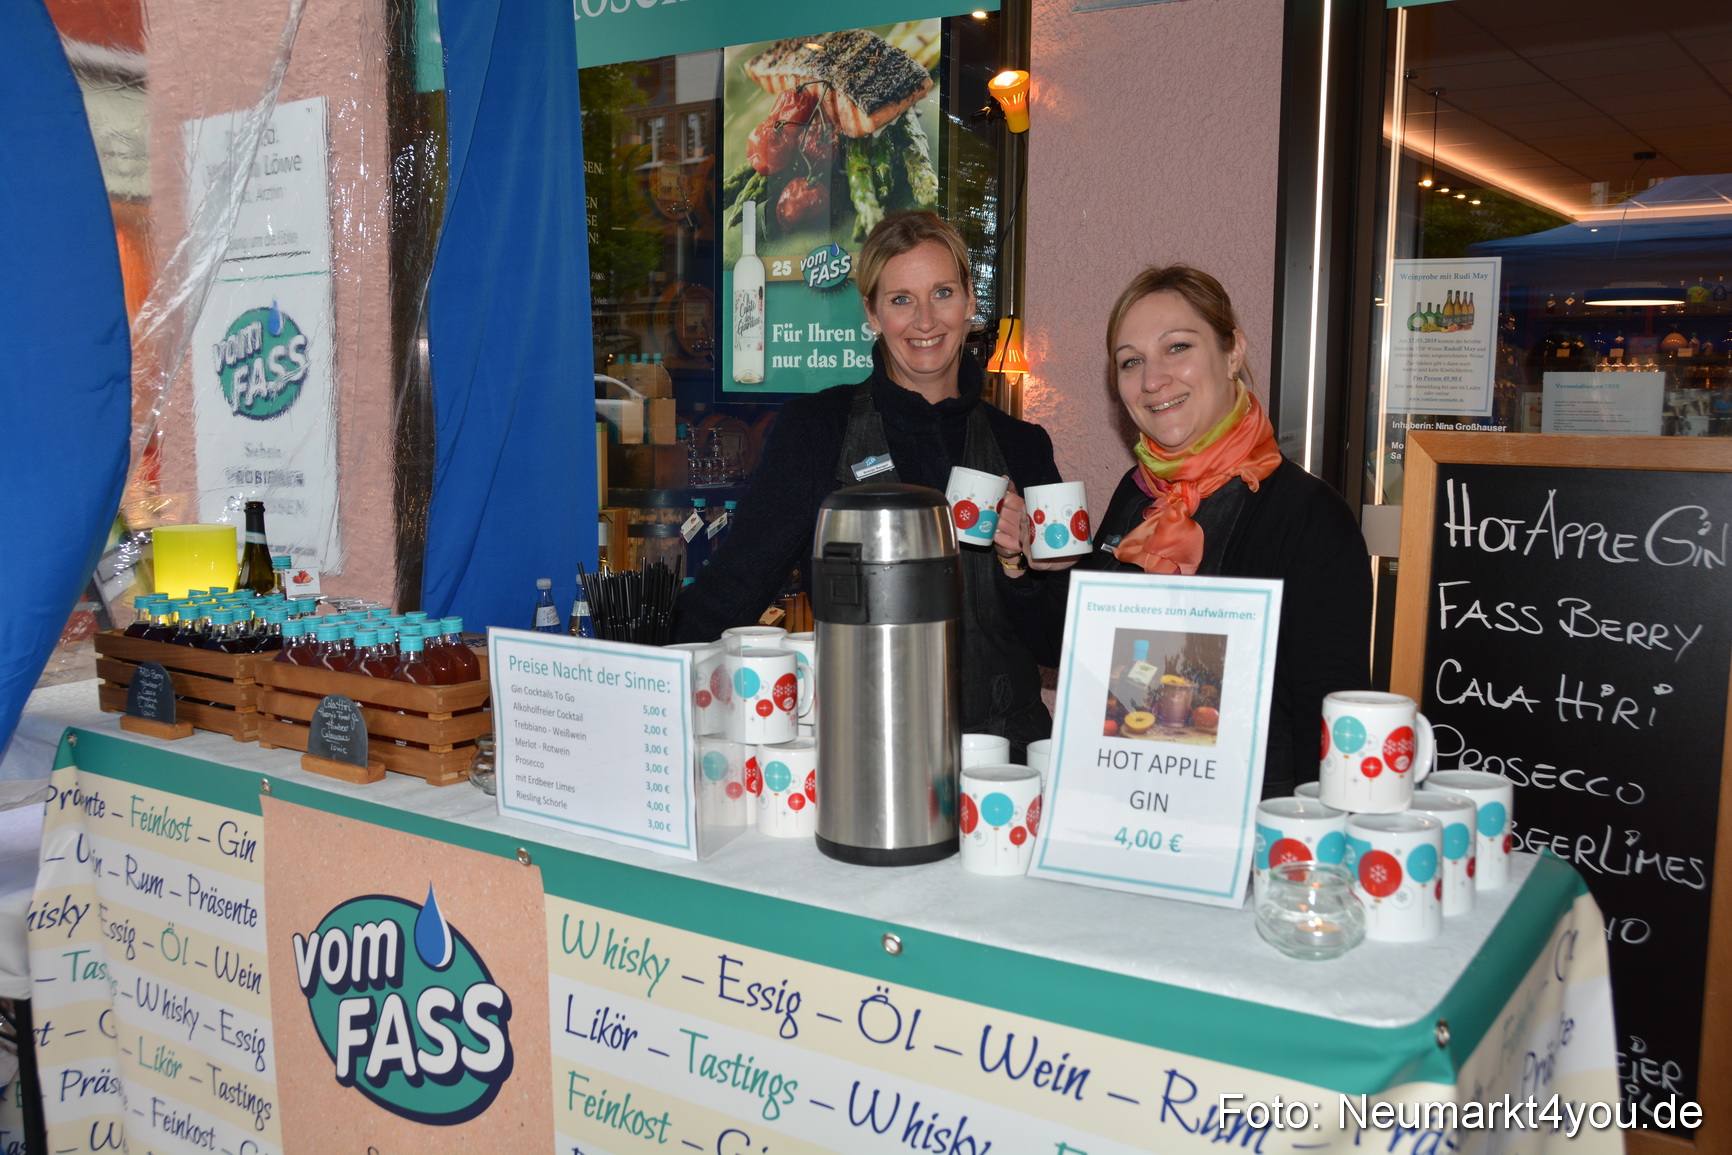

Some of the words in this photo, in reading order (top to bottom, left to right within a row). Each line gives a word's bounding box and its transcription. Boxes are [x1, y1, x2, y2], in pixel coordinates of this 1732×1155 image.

[772, 260, 793, 277] 25
[800, 249, 827, 272] vom
[809, 254, 852, 287] FASS
[1400, 273, 1438, 281] Weinprobe
[1472, 273, 1489, 281] May
[772, 323, 802, 342] Für
[808, 322, 856, 342] Ihren
[772, 354, 801, 368] nur
[807, 348, 837, 368] das
[1392, 421, 1434, 430] Inhaberin:
[1435, 422, 1454, 431] Nina
[1455, 422, 1507, 432] Großhauser
[1391, 441, 1404, 449] Mo
[1390, 452, 1402, 460] Sa
[1086, 601, 1117, 613] Etwas
[1118, 603, 1163, 616] Leckeres
[1164, 606, 1187, 617] zum
[1189, 606, 1256, 621] Aufwärmen:
[1437, 580, 1544, 635] FASS
[1557, 597, 1704, 663] BERRY
[508, 655, 549, 676] Preise
[552, 661, 593, 683] Nacht
[597, 667, 621, 687] der
[624, 671, 671, 694] Sinne:
[510, 684, 523, 694] Gin
[523, 686, 554, 700] Cocktails
[554, 690, 564, 701] To
[564, 692, 575, 703] Go
[1435, 658, 1541, 714] CALA
[512, 702, 555, 717] Alkoholfreier
[556, 708, 584, 722] Cocktail
[643, 705, 660, 717] 5,00
[661, 708, 667, 717] €
[514, 720, 547, 735] Trebbiano
[552, 726, 587, 741] Weißwein
[643, 724, 661, 736] 2,00
[662, 728, 668, 737] €
[514, 737, 538, 749] Merlot
[542, 742, 570, 756] Rotwein
[644, 743, 662, 755] 3,00
[663, 747, 668, 756] €
[515, 755, 545, 769] Prosecco
[645, 762, 662, 774] 3,00
[663, 766, 669, 775] €
[1097, 748, 1143, 771] HOT
[1148, 754, 1217, 780] APPLE
[1432, 724, 1645, 805] PROSECCO
[515, 773, 527, 784] mit
[528, 775, 554, 790] Erdbeer
[555, 781, 575, 794] Limes
[646, 781, 663, 793] 3,00
[664, 785, 670, 794] €
[516, 790, 542, 805] Riesling
[542, 795, 568, 810] Schorle
[646, 800, 664, 812] 4,00
[665, 804, 671, 813] €
[1129, 790, 1169, 813] GIN
[130, 795, 193, 843] Feinkost
[217, 820, 257, 863] Gin
[648, 819, 665, 831] 3,00
[666, 823, 671, 832] €
[1114, 826, 1162, 852] 4,00
[1168, 833, 1184, 853] €
[125, 854, 164, 899] Rum
[188, 873, 258, 928] Präsente
[161, 922, 188, 966] Öl
[215, 946, 262, 995] Wein
[292, 917, 404, 997] vom
[561, 913, 670, 998] Whisky
[718, 954, 802, 1040] Essig
[858, 985, 921, 1051] Öl
[979, 1024, 1091, 1101] Wein
[136, 977, 200, 1041] Whisky
[219, 1008, 266, 1072] Essig
[336, 981, 512, 1087] FASS
[565, 993, 639, 1051] Likör
[679, 1027, 799, 1121] Tastings
[138, 1036, 182, 1079] Likör
[206, 1062, 272, 1132] Tastings
[567, 1070, 673, 1145] Feinkost
[151, 1097, 216, 1151] Feinkost
